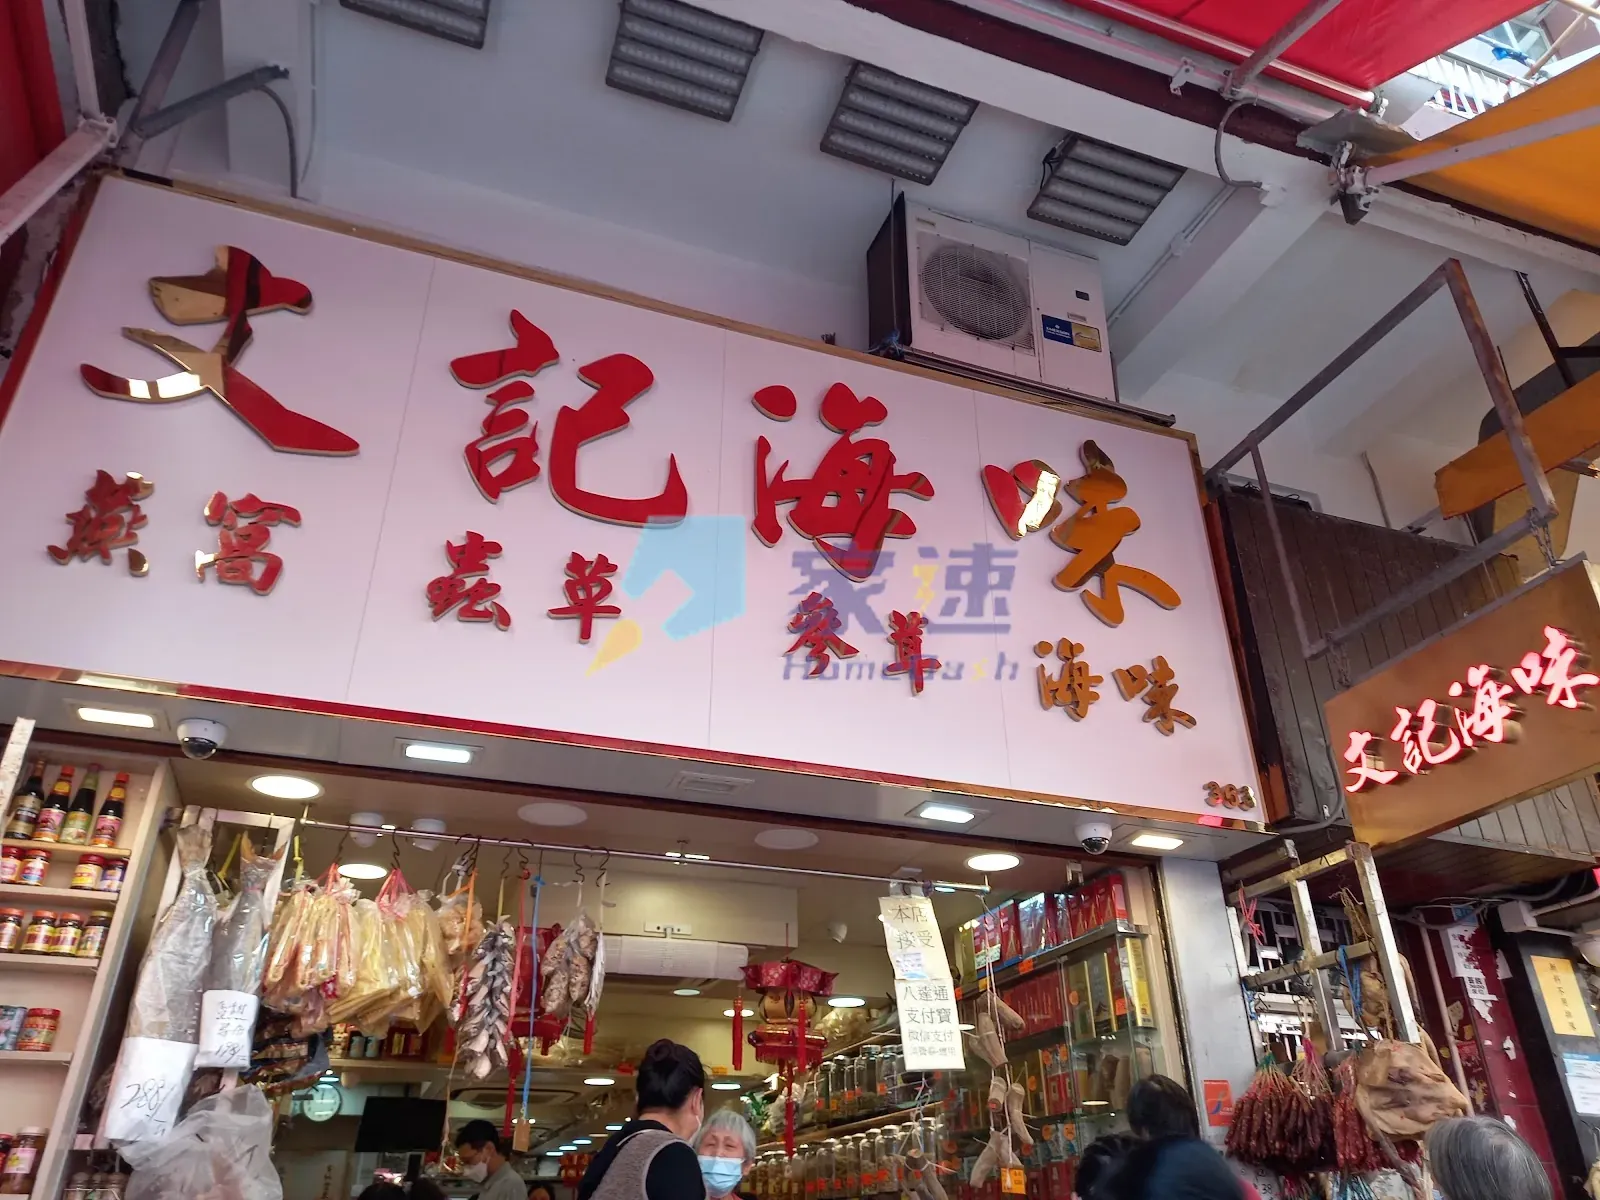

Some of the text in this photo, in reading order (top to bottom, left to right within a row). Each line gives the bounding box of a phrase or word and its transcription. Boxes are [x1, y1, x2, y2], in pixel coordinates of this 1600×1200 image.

[80, 244, 1182, 629] 文記海味
[46, 469, 303, 596] 燕窩
[426, 531, 622, 644] 蟲草
[1035, 637, 1196, 736] 海味
[1343, 625, 1600, 793] 文記海味
[1202, 780, 1257, 811] 363
[890, 904, 928, 924] 本店
[895, 930, 936, 949] 接受
[903, 985, 950, 1002] 八達通
[905, 1007, 952, 1024] 支付寶
